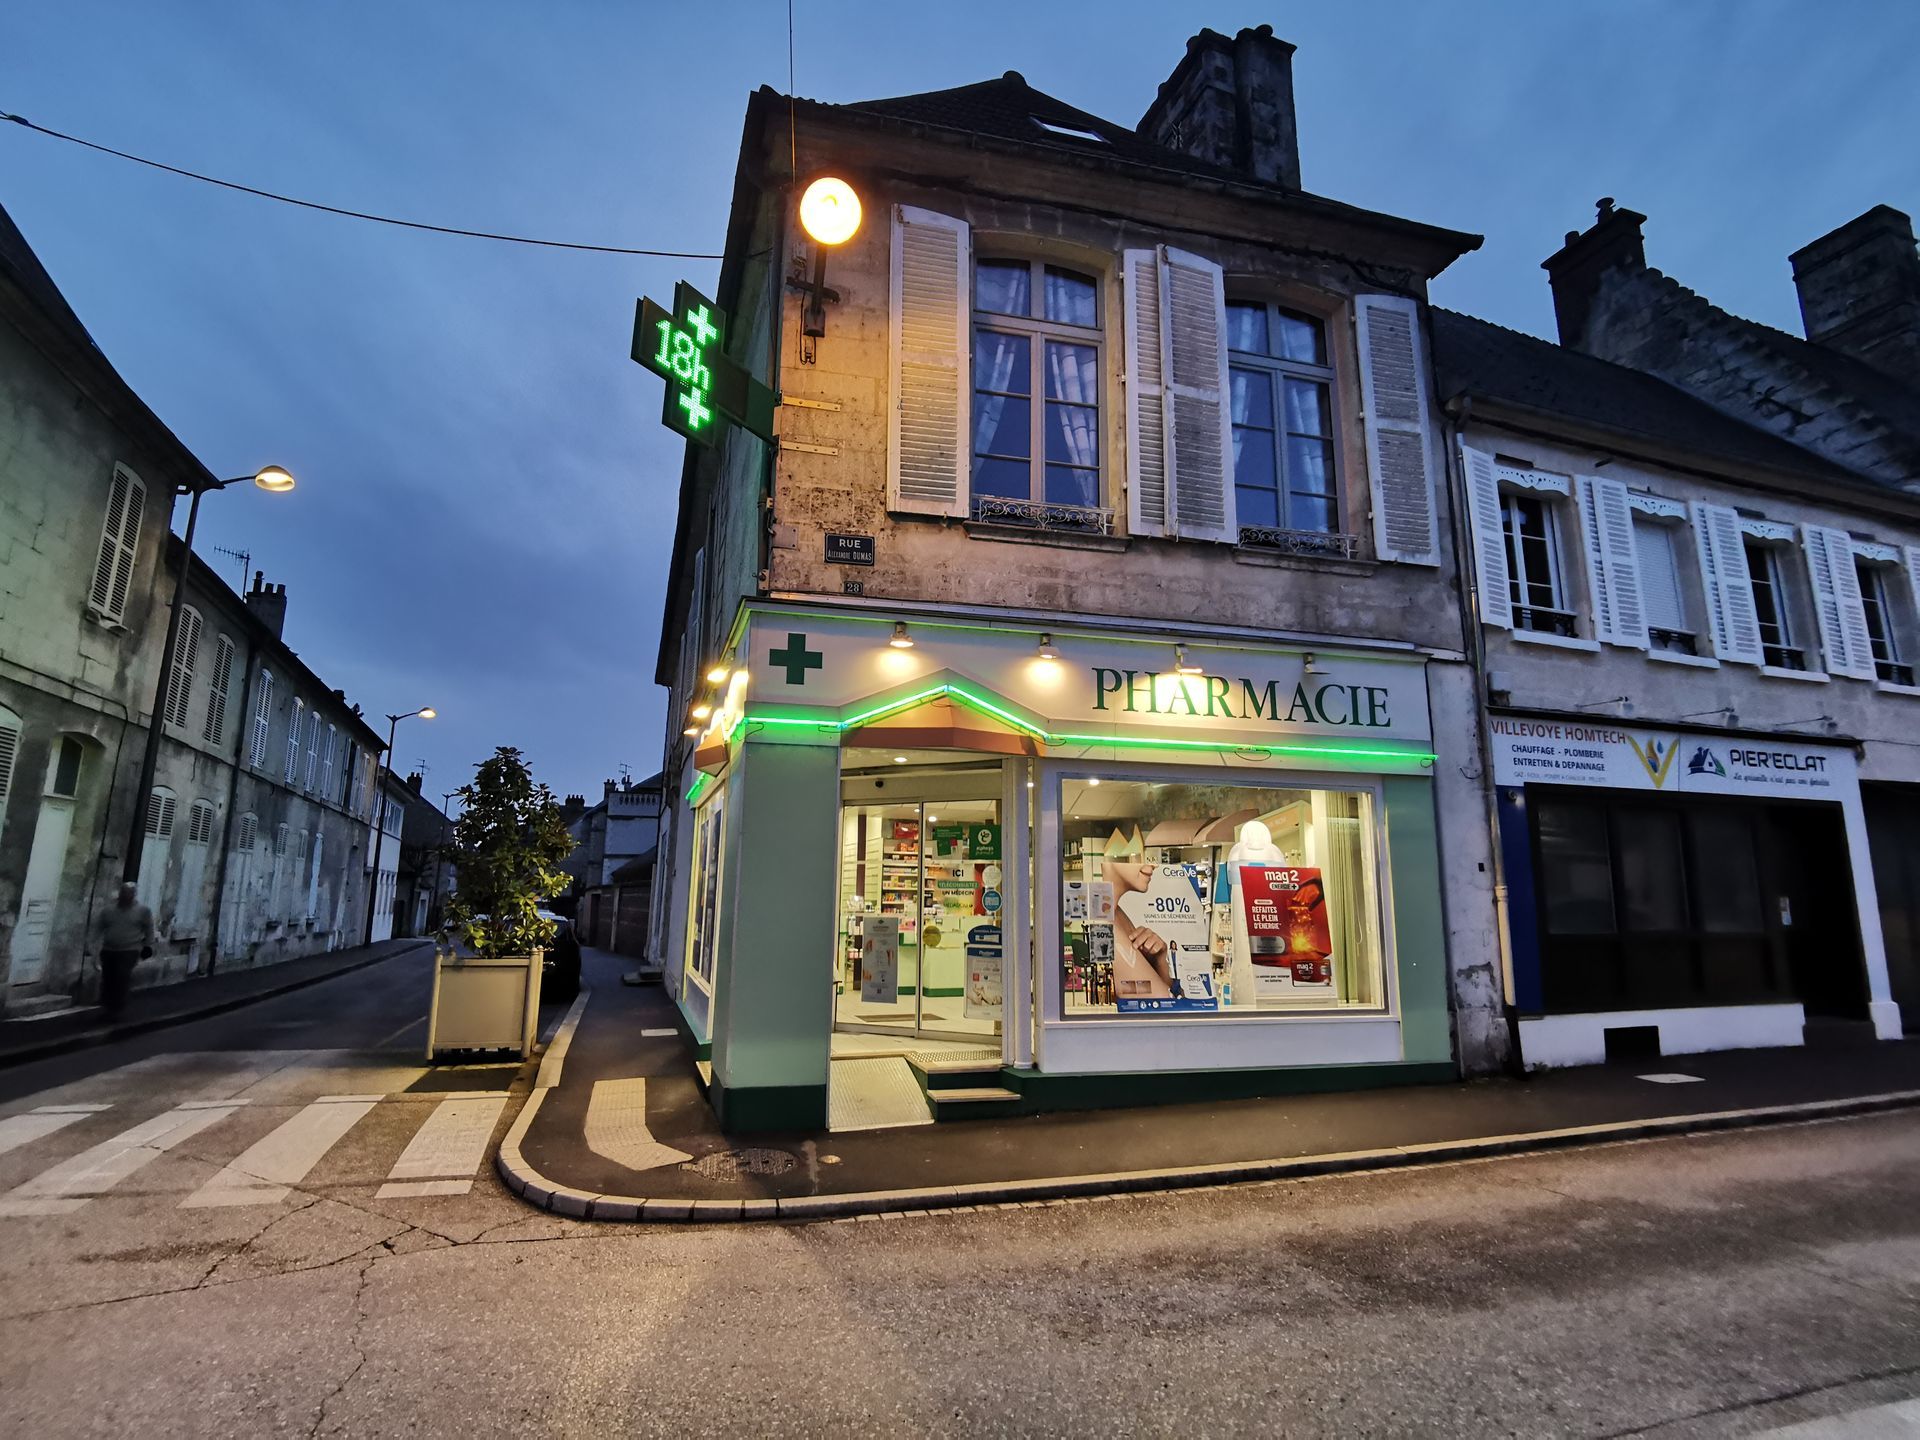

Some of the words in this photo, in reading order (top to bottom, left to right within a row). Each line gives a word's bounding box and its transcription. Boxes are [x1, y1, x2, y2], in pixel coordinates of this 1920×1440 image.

[655, 319, 710, 392] 18h
[839, 538, 861, 549] RUE
[846, 583, 860, 592] 28
[1092, 667, 1391, 728] PHARMACIE
[1491, 721, 1561, 740] VILLEVOYE
[1564, 728, 1626, 744] HOMTECH
[1511, 744, 1555, 756] CHAUFFAGE
[1564, 748, 1604, 759] PLOMBERIE
[1513, 757, 1553, 768] ENTRETIEN
[1562, 760, 1605, 771] DEPANNAGE
[1729, 749, 1827, 772] PIER'ECLAT
[952, 869, 964, 877] ICI
[1162, 867, 1197, 877] CeraVe
[1264, 871, 1289, 883] mag
[1290, 869, 1299, 881] 2
[1148, 897, 1190, 912] -80%
[1261, 914, 1279, 922] PLEIN
